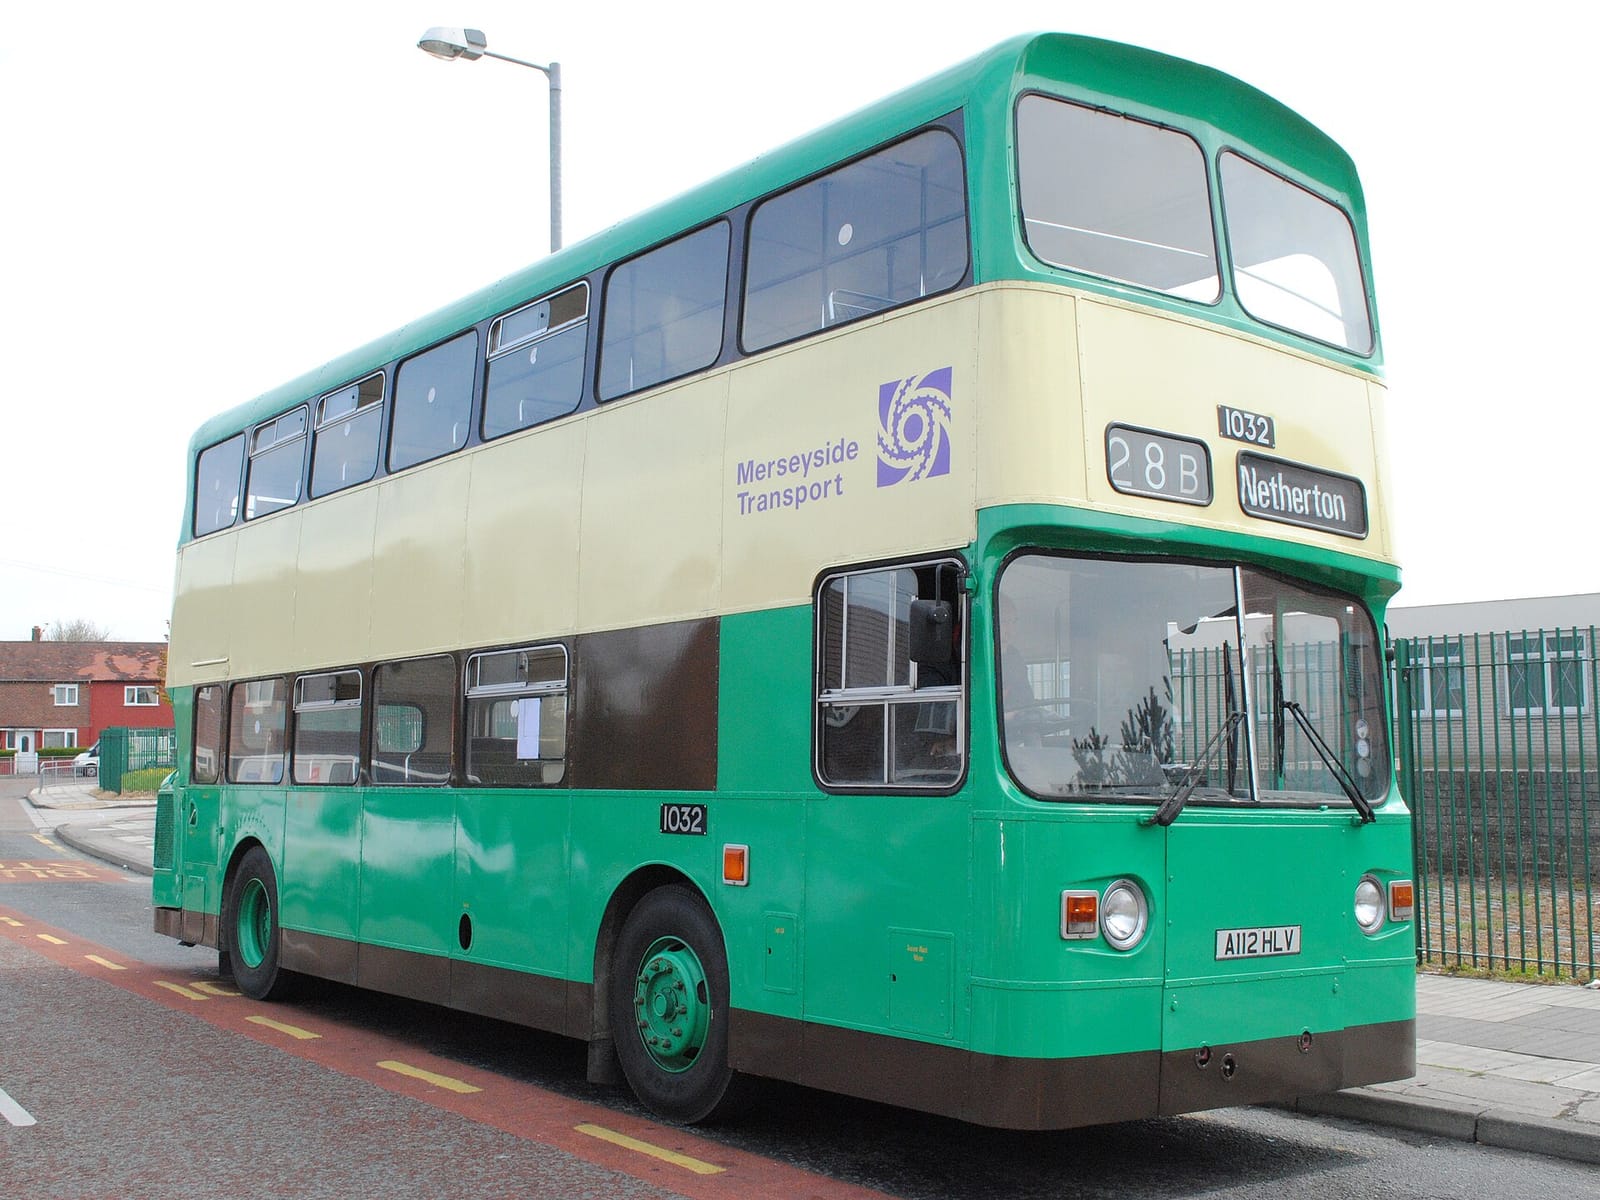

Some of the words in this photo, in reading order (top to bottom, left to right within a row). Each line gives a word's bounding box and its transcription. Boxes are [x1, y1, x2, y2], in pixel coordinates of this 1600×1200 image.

[1224, 408, 1270, 445] 1032
[736, 437, 860, 486] Merseyside
[736, 472, 844, 516] Transport
[1239, 464, 1347, 522] Netherton
[663, 805, 703, 833] 1032
[1224, 931, 1258, 956] A112
[1262, 929, 1294, 953] HLV
